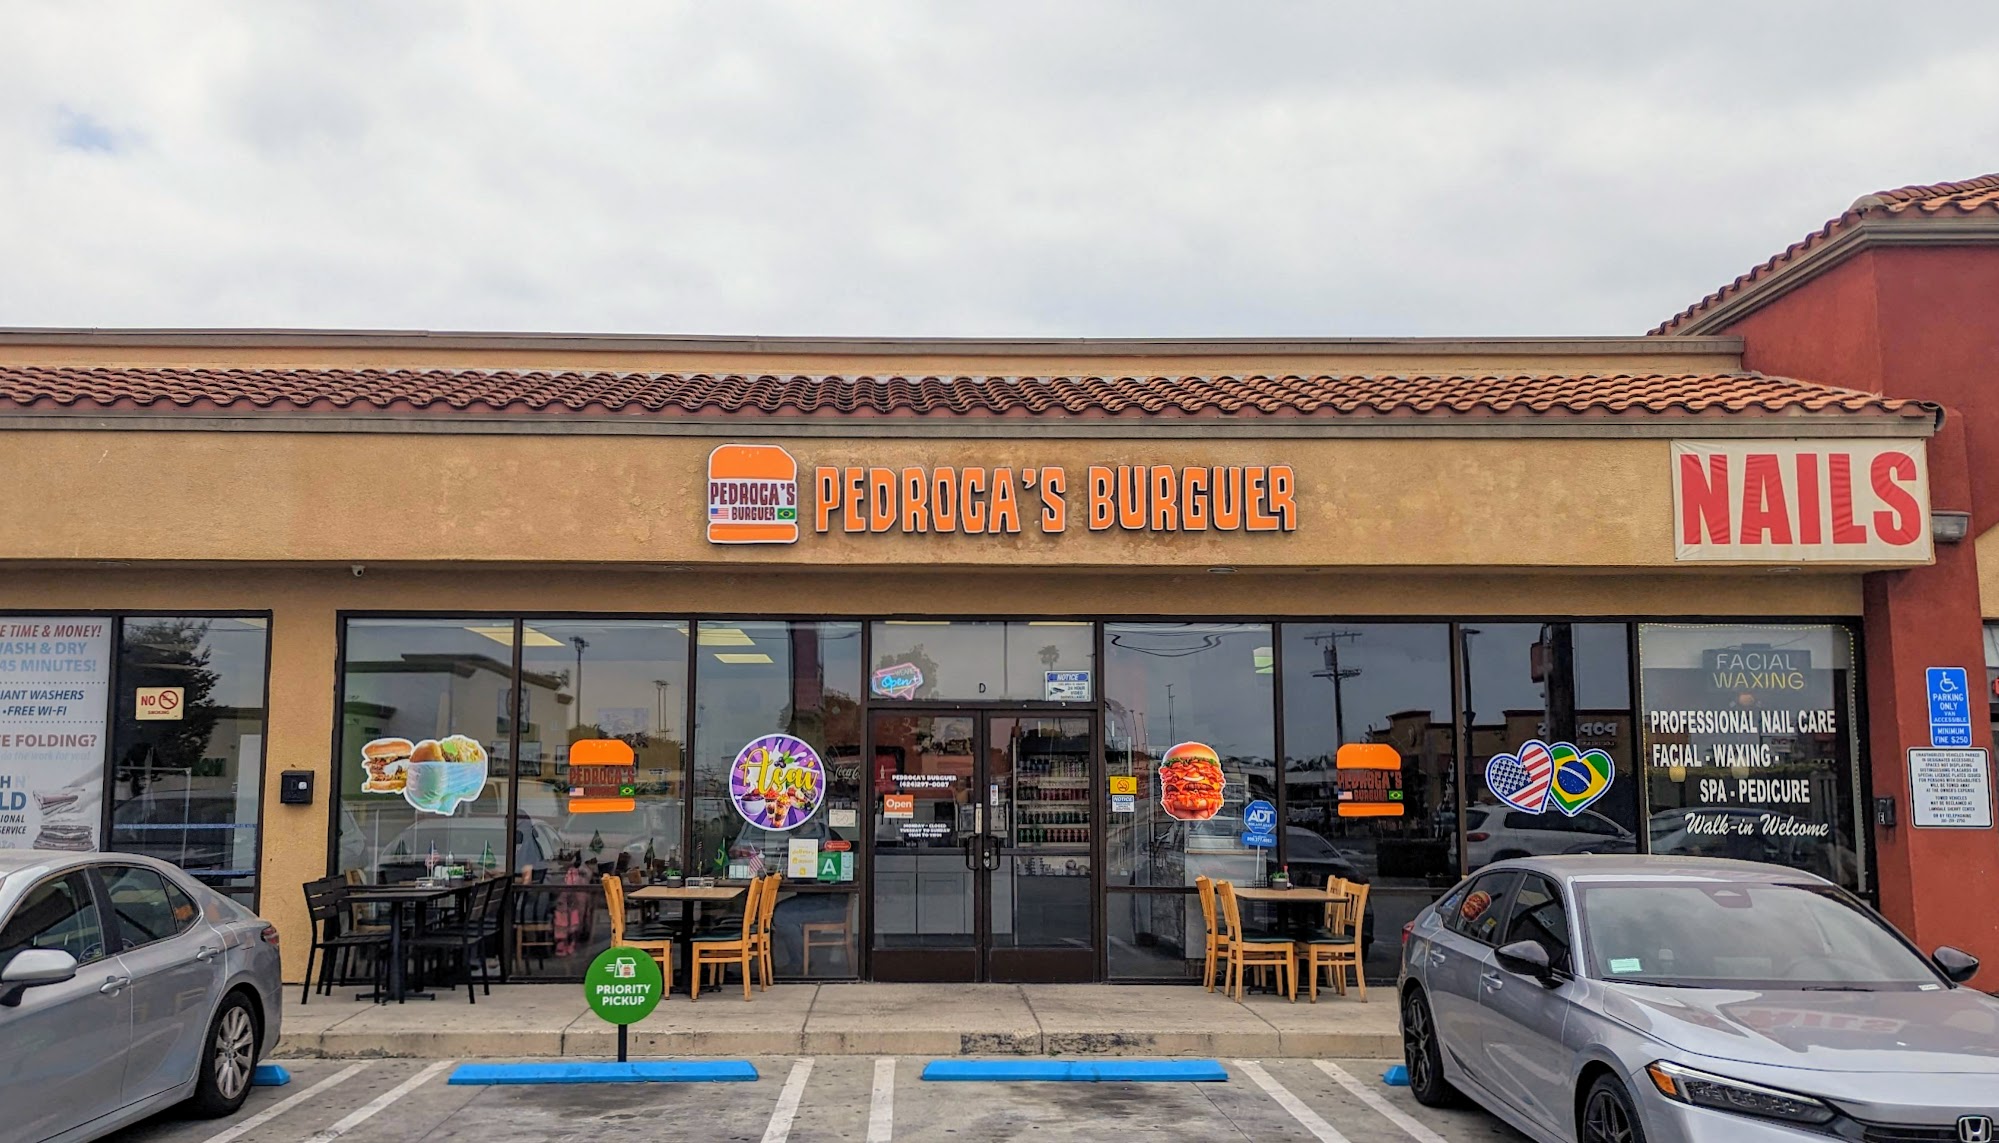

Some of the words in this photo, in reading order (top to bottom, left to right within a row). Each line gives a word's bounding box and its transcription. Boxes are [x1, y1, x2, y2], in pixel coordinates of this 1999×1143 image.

[710, 482, 795, 505] PEDROCA'S
[815, 466, 1066, 533] PEDROCA'S
[1088, 465, 1296, 532] BURGUER
[1680, 451, 1921, 545] NAILS
[731, 507, 775, 520] BURGUER
[10, 625, 39, 637] TIME
[41, 625, 51, 637] &
[54, 625, 102, 638] MONEY!
[40, 642, 51, 654] &
[55, 642, 87, 654] DRY
[21, 660, 97, 672] MINUTES!
[1717, 654, 1797, 671] FACIAL
[881, 676, 912, 693] Open
[1713, 672, 1804, 690] WAXING
[979, 683, 986, 693] D
[30, 690, 84, 700] WASHERS
[141, 696, 156, 706] NO
[1933, 693, 1964, 702] PARKING
[38, 706, 67, 716] WI-FI
[1940, 702, 1958, 711] ONLY
[1651, 711, 1757, 734] PROFESSIONAL
[1761, 711, 1795, 734] NAIL
[1798, 711, 1836, 734] CARE
[0, 734, 10, 747] E
[16, 734, 97, 747] FOLDING?
[1935, 736, 1949, 744] FINE
[1951, 736, 1969, 744] $250
[1653, 744, 1702, 768] FACIAL
[1713, 744, 1771, 768] WAXING
[1700, 779, 1727, 803] SPA
[1739, 779, 1810, 803] PEDICURE
[886, 799, 912, 809] Open
[1248, 810, 1274, 823] ADT
[1685, 813, 1754, 836] Walk-in
[1760, 814, 1829, 836] Welcome
[821, 859, 837, 875] A
[596, 984, 651, 994] PRIORITY
[602, 996, 645, 1006] PICKUP
